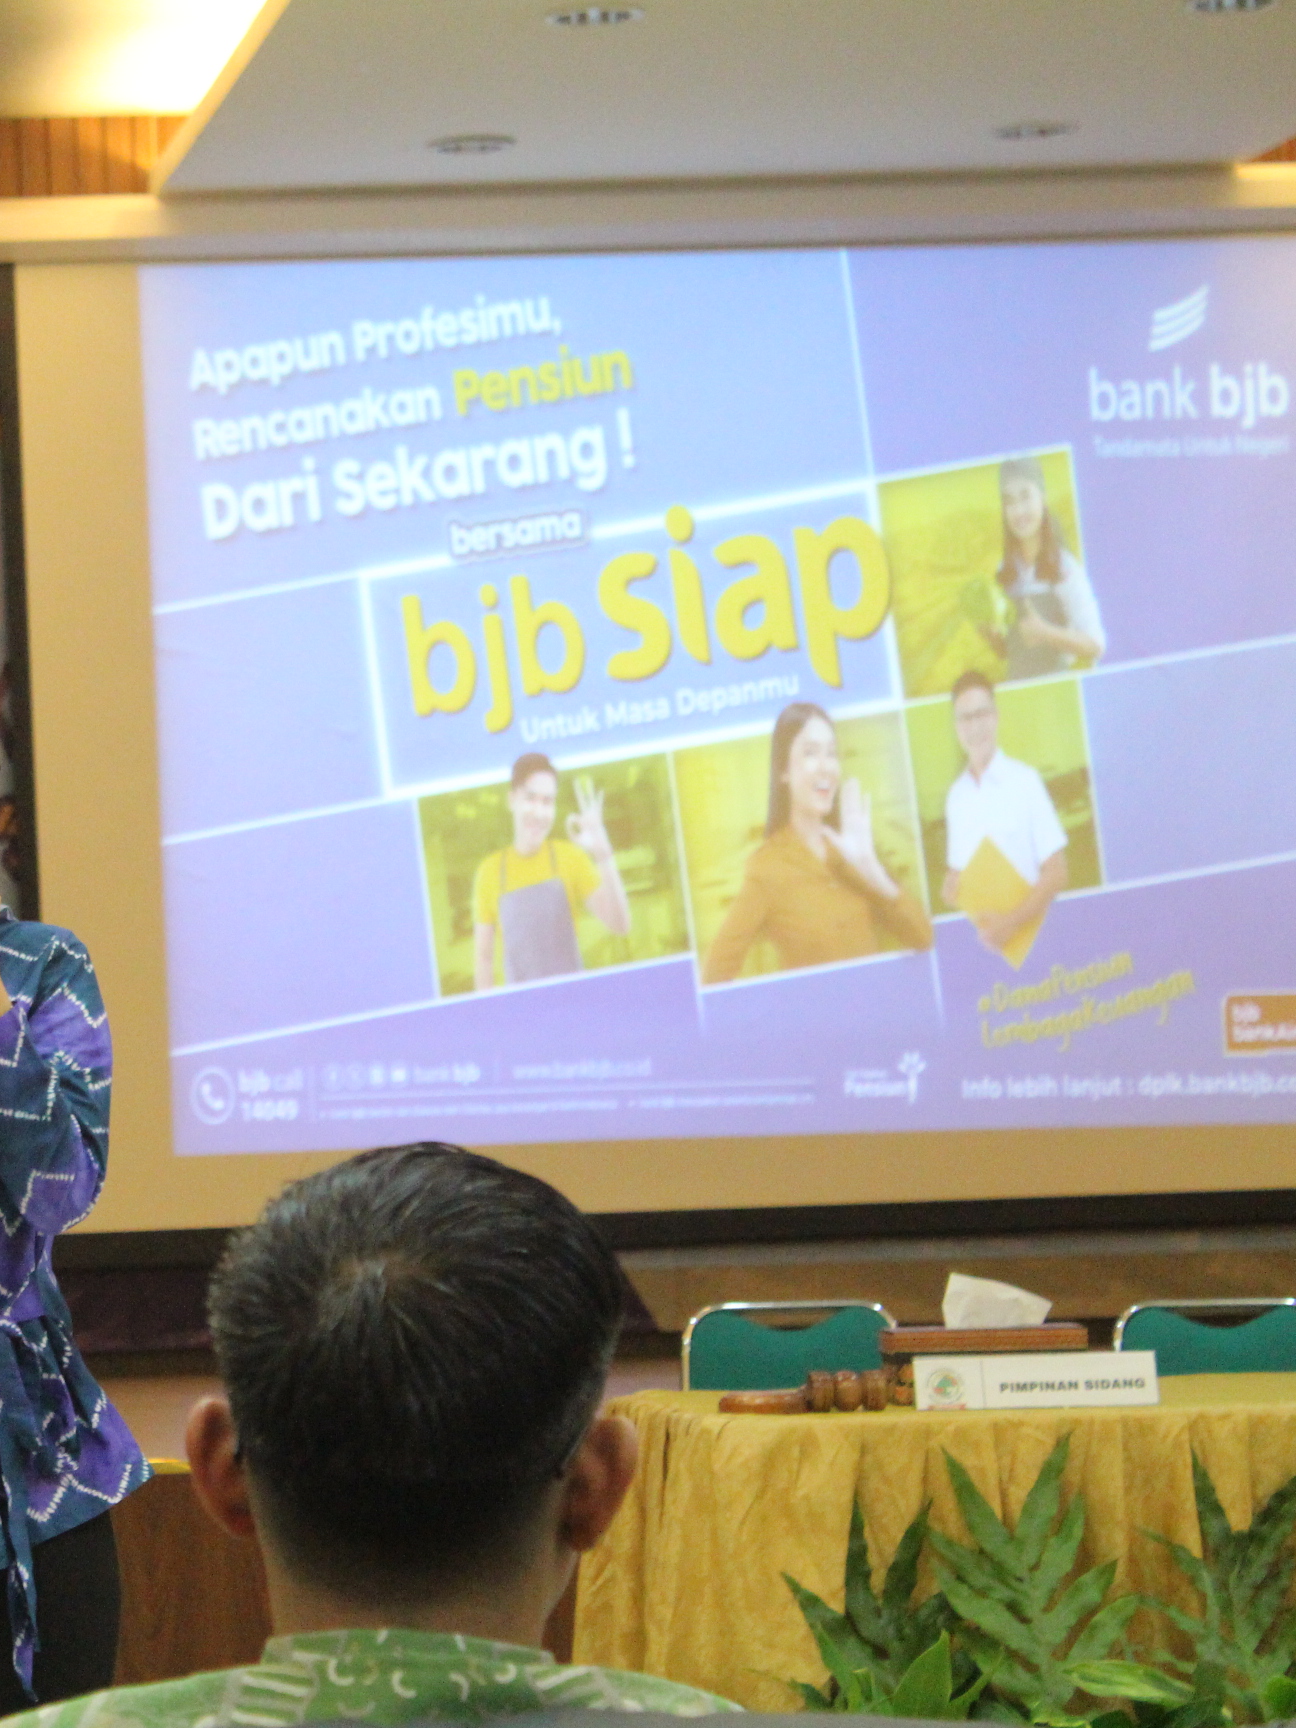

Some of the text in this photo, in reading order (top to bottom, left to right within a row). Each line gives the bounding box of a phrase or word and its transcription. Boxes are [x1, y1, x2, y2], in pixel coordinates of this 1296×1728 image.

[189, 295, 562, 394] Apapun Profesimu,
[193, 345, 634, 460] Rencanakan Pensiun
[1089, 362, 1291, 429] bank bjb
[200, 457, 322, 540] Dari
[333, 424, 609, 517] Sekarang
[450, 511, 582, 556] bersama
[401, 505, 892, 734] bjb siap
[520, 674, 800, 745] Untuk Masa Depanmu
[962, 1075, 1003, 1098] Info
[1008, 1071, 1058, 1098] lebih
[1063, 1071, 1122, 1101] lanjut
[999, 1377, 1146, 1393] PIMPINAN SIDANG
